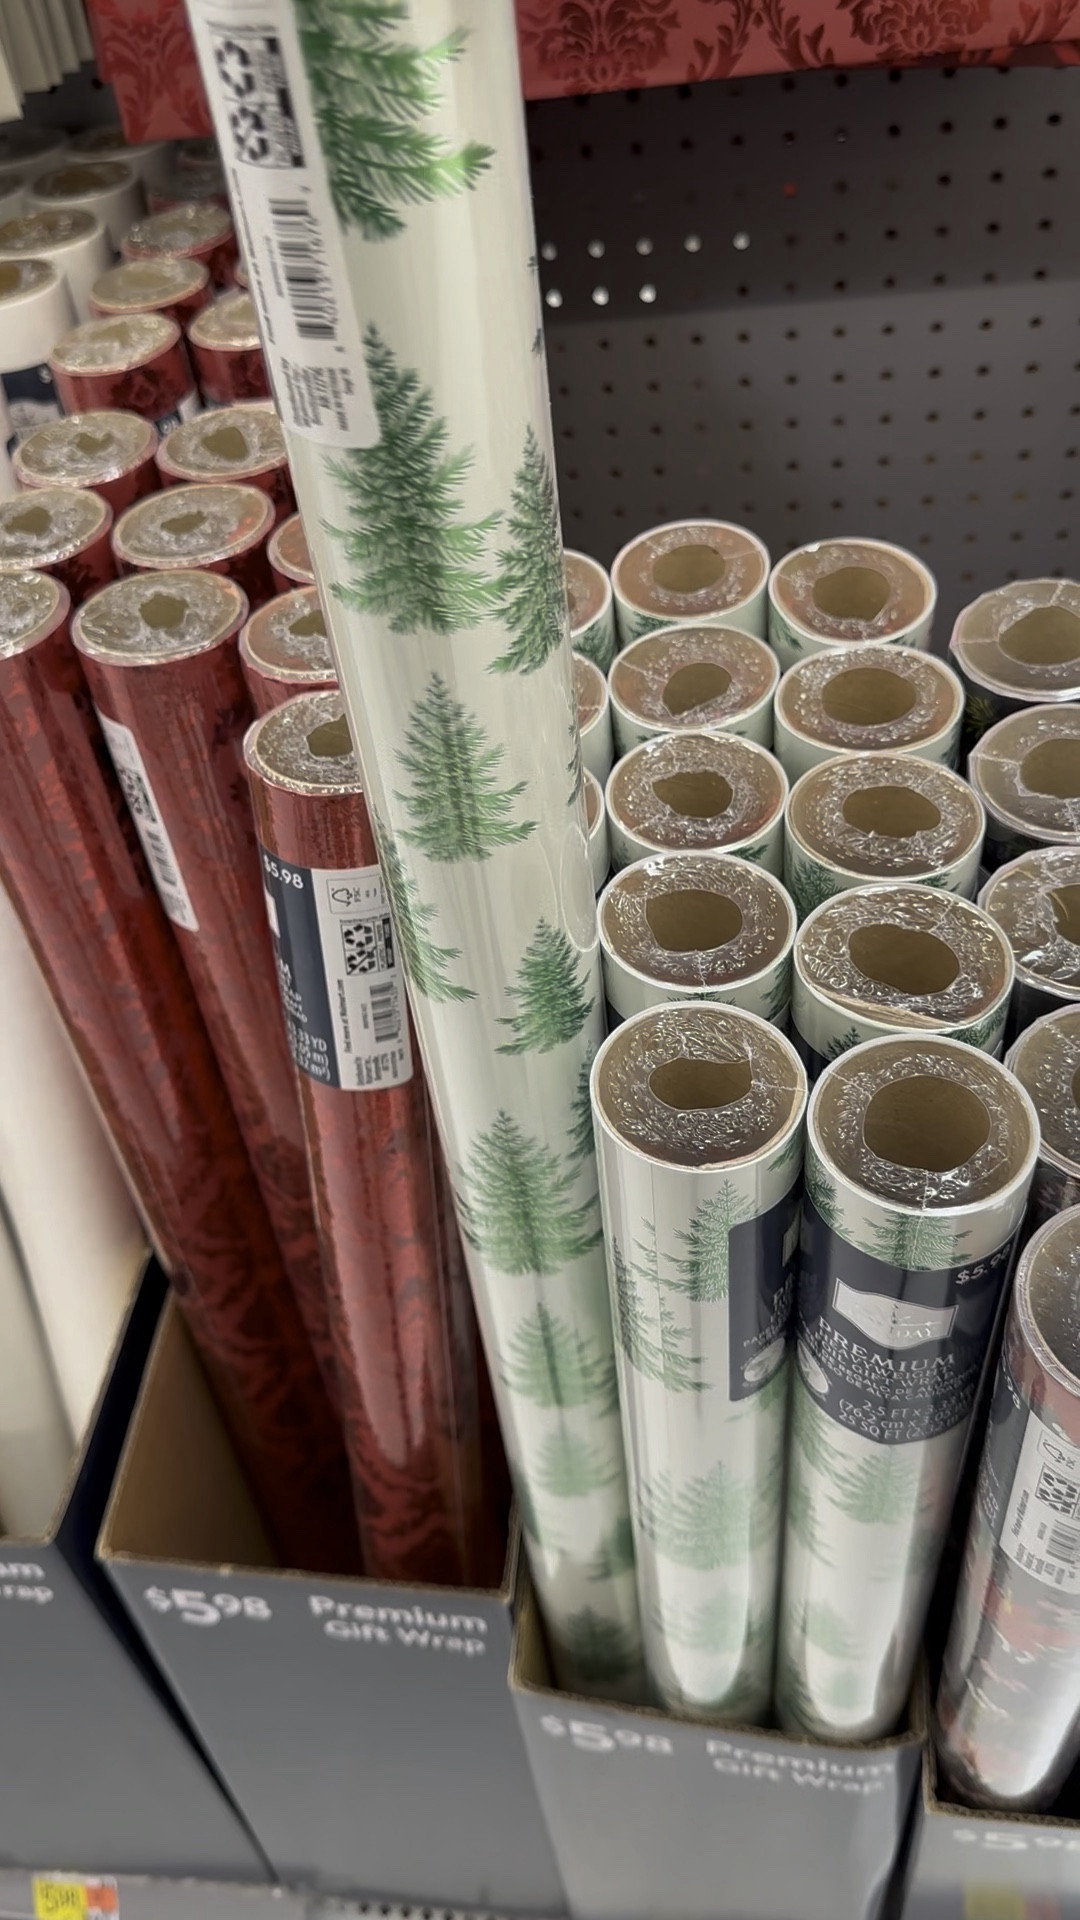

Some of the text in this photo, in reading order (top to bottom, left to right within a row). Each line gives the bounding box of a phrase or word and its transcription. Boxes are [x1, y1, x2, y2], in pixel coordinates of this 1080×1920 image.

[819, 1314, 955, 1372] PREMIUM
[839, 1399, 877, 1425] (76.2
[881, 1420, 904, 1429] cm
[862, 1400, 886, 1416] 2.5
[891, 1408, 910, 1418] FT
[309, 1594, 488, 1634] Premium
[324, 1618, 486, 1658] Gift Wrap
[706, 1739, 894, 1777] Premium
[713, 1757, 884, 1796] Gift Wrap
